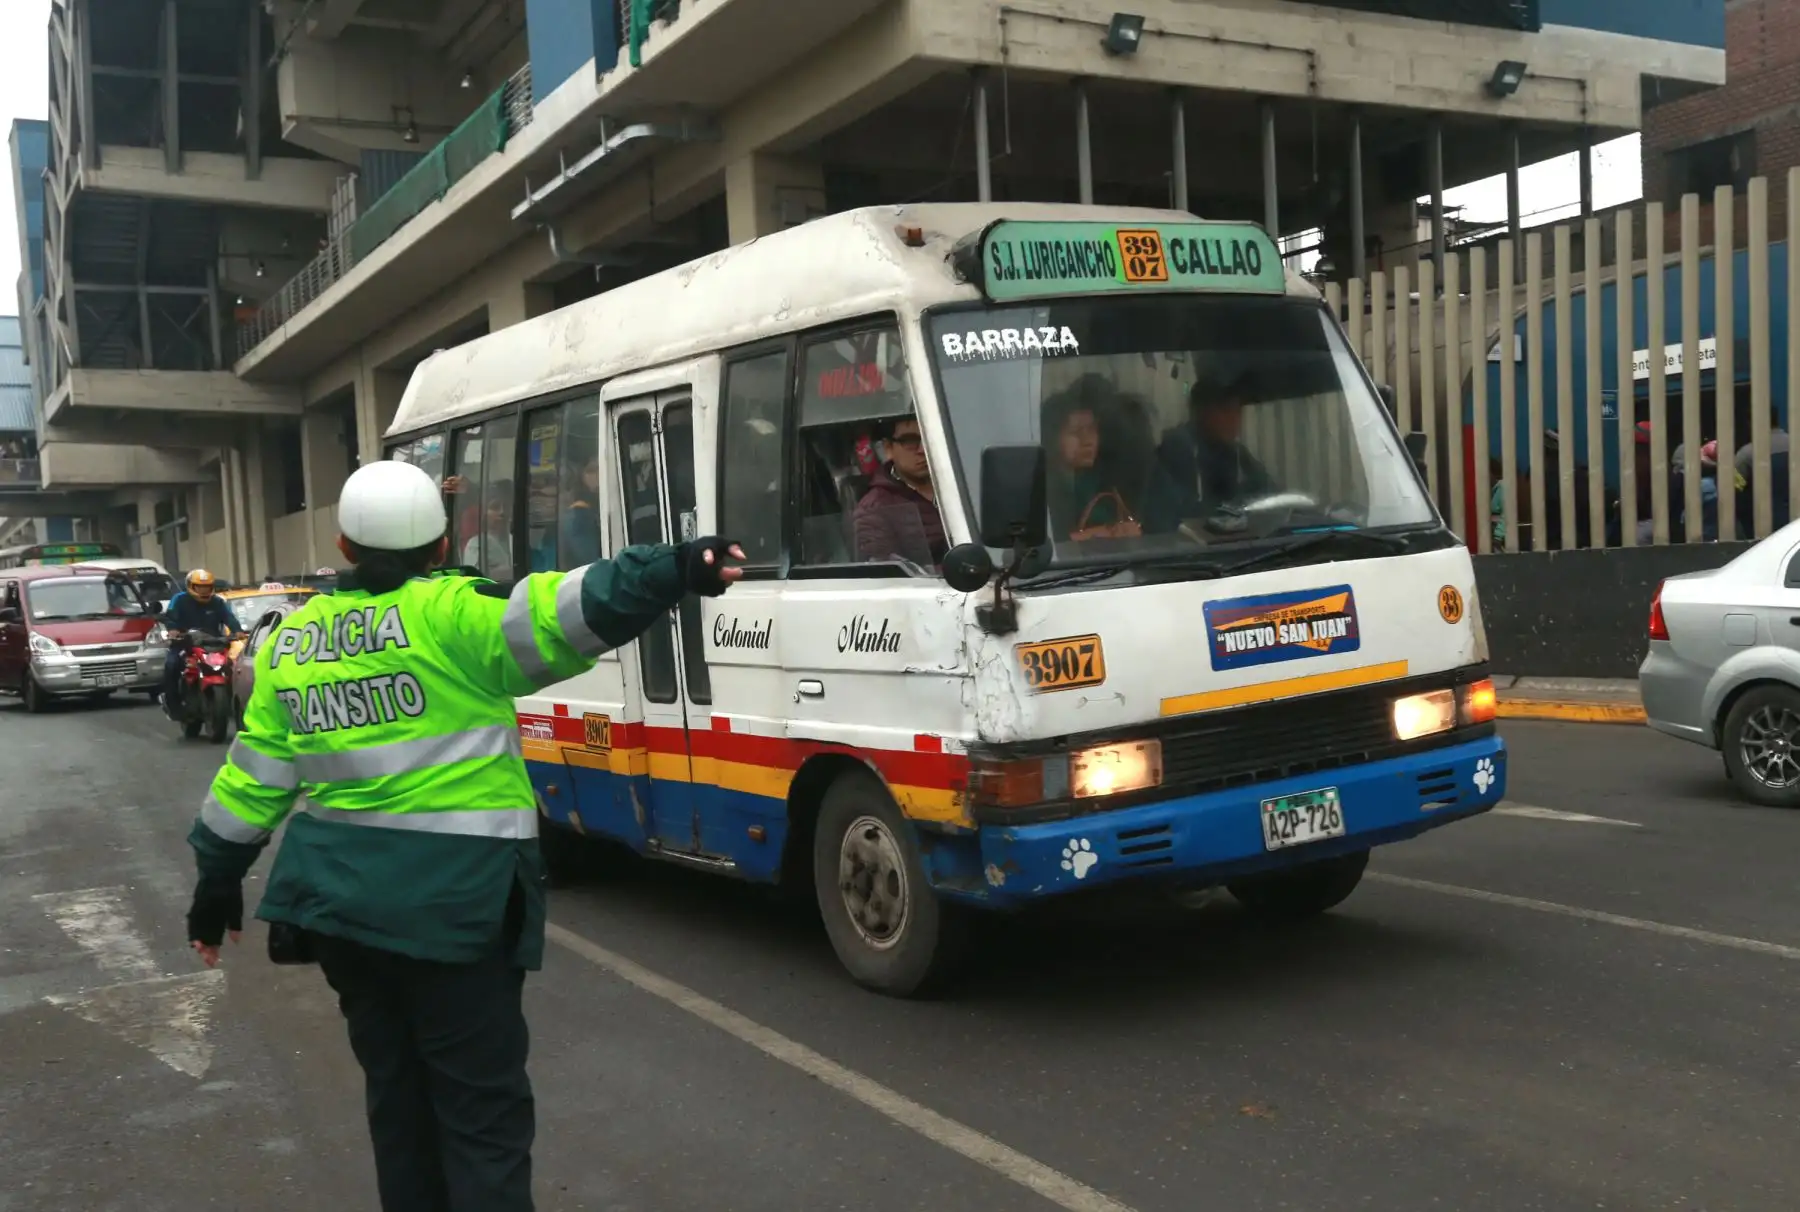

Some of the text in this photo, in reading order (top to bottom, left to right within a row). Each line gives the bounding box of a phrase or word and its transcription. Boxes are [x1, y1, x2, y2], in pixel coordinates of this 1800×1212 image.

[1020, 240, 1116, 279] LURIGANCHO
[1124, 236, 1158, 255] 39
[1170, 238, 1261, 276] CALLAO
[1129, 256, 1160, 277] 07
[942, 326, 1079, 361] BARRAZA
[270, 605, 410, 669] POLICIA
[713, 613, 773, 649] Colonial
[838, 614, 901, 653] Minka
[1279, 622, 1309, 644] SAN
[1023, 644, 1095, 685] 3907
[586, 718, 608, 744] 3907
[1269, 800, 1339, 841] A2P-726
